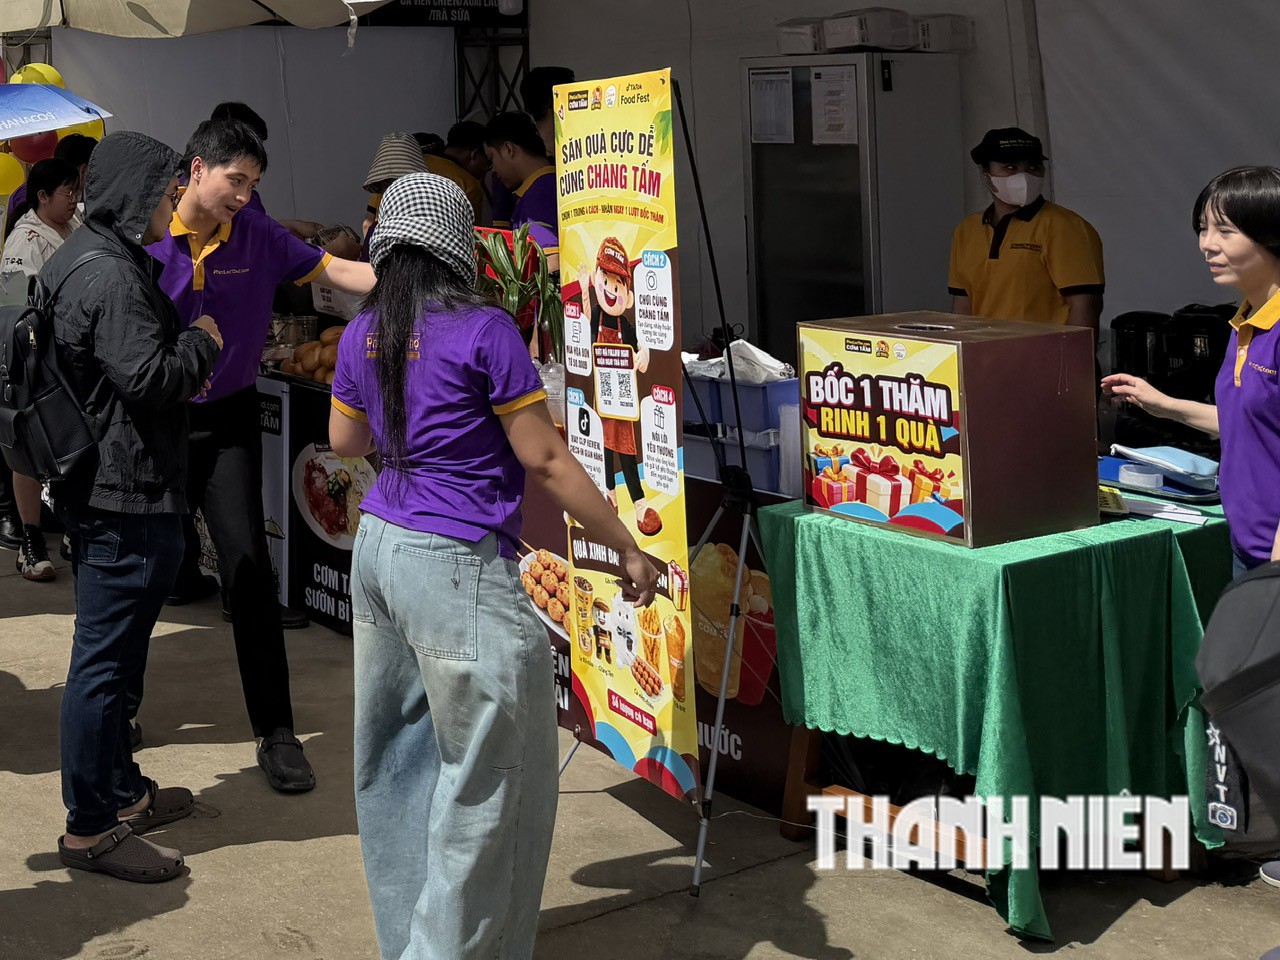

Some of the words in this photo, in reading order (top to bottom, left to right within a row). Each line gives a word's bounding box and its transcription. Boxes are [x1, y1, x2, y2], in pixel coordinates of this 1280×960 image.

[620, 94, 636, 105] Food
[636, 93, 650, 104] Fest
[610, 130, 634, 158] CỰC
[638, 124, 655, 158] DỄ
[560, 168, 584, 198] CÙNG
[587, 158, 628, 191] CHÀNG
[631, 159, 662, 199] TẤM
[643, 251, 659, 267] CÁCH
[659, 253, 665, 267] 2
[809, 365, 855, 406] BỐC
[859, 378, 871, 408] 1
[878, 377, 949, 422] THĂM
[820, 406, 870, 440] RINH
[876, 414, 887, 442] 1
[895, 418, 942, 454] QUÀ
[572, 536, 588, 559] QUÀ
[588, 541, 607, 564] XINH
[313, 562, 339, 591] CƠM
[305, 586, 336, 617] SƯỜN
[338, 598, 350, 622] BÌ
[610, 692, 620, 712] Số
[634, 709, 642, 722] có
[641, 713, 655, 732] hạn
